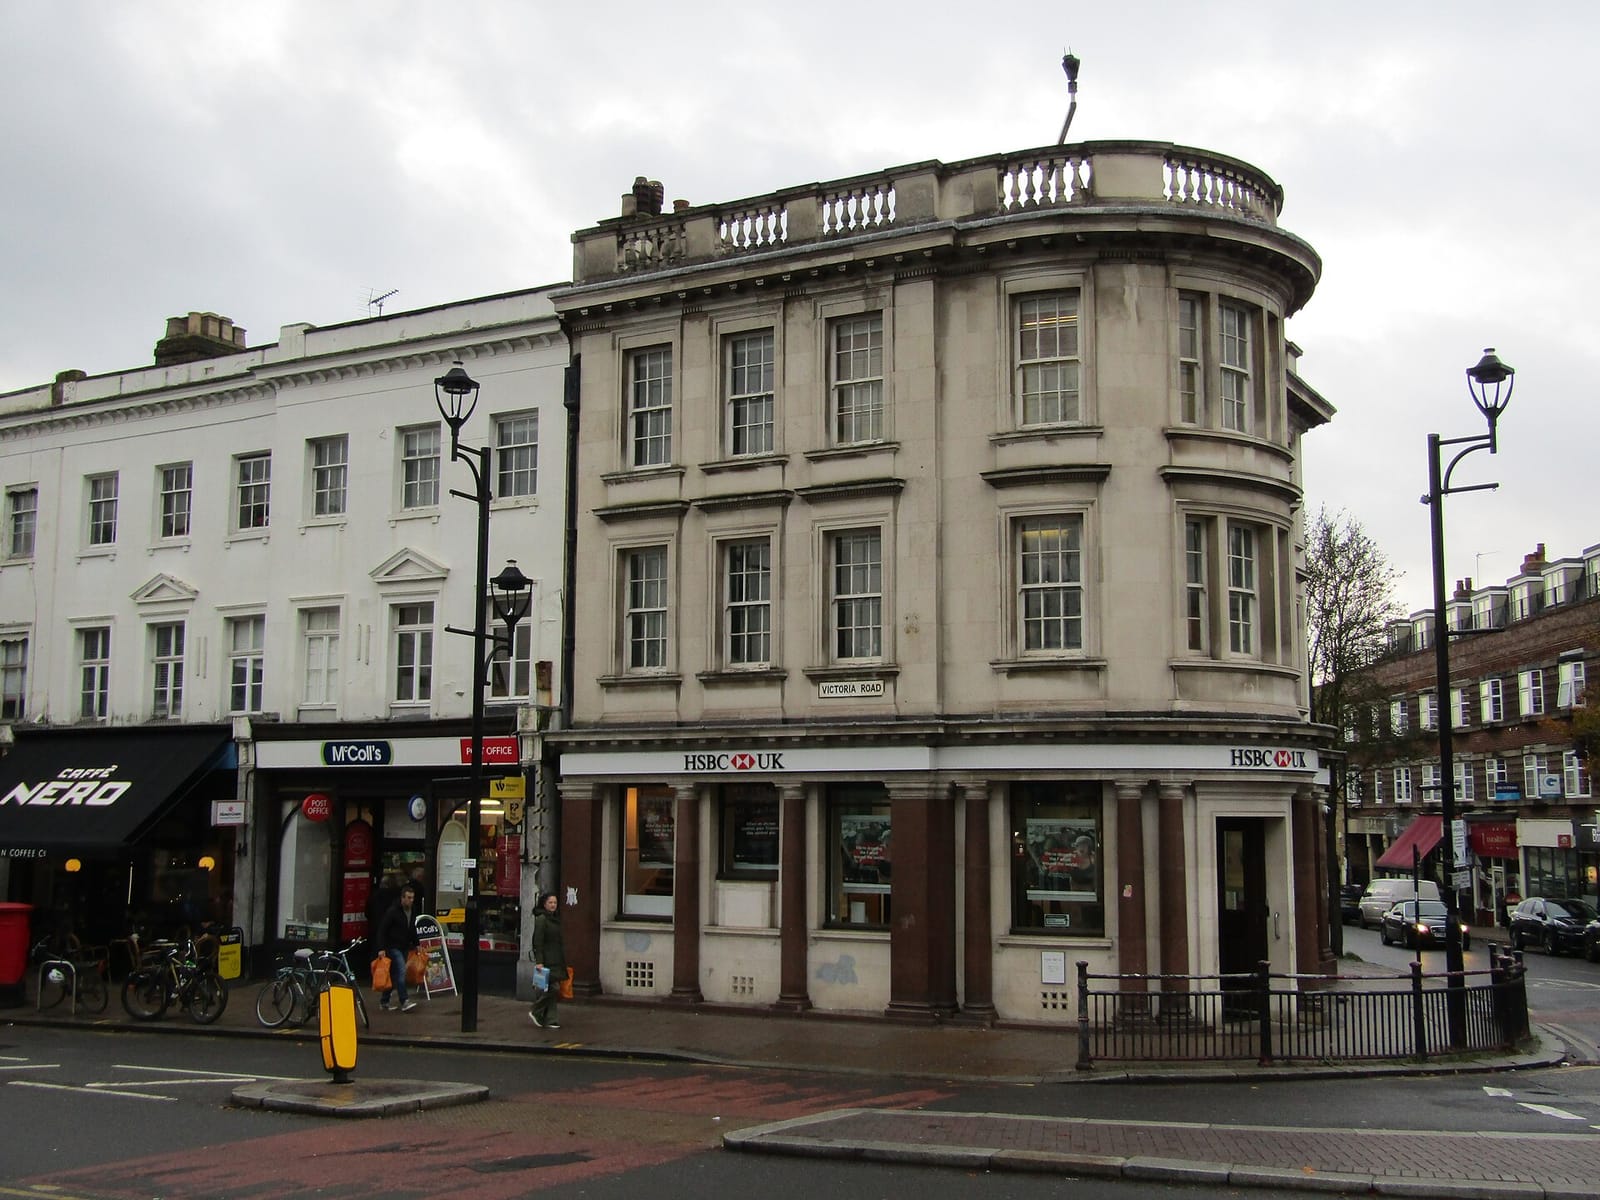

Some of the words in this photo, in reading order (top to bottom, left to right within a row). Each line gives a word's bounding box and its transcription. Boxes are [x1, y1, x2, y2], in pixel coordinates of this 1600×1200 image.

[822, 684, 857, 695] VICTORIA
[860, 683, 882, 693] ROAD
[486, 745, 513, 756] OFFICE
[684, 753, 730, 771] HSBC
[756, 752, 785, 770] UK
[1230, 748, 1273, 768] HSBC
[1290, 750, 1307, 768] UK
[0, 780, 133, 806] NERO
[311, 799, 328, 807] POST
[307, 807, 329, 815] OFFICE
[9, 848, 36, 858] COFFEE
